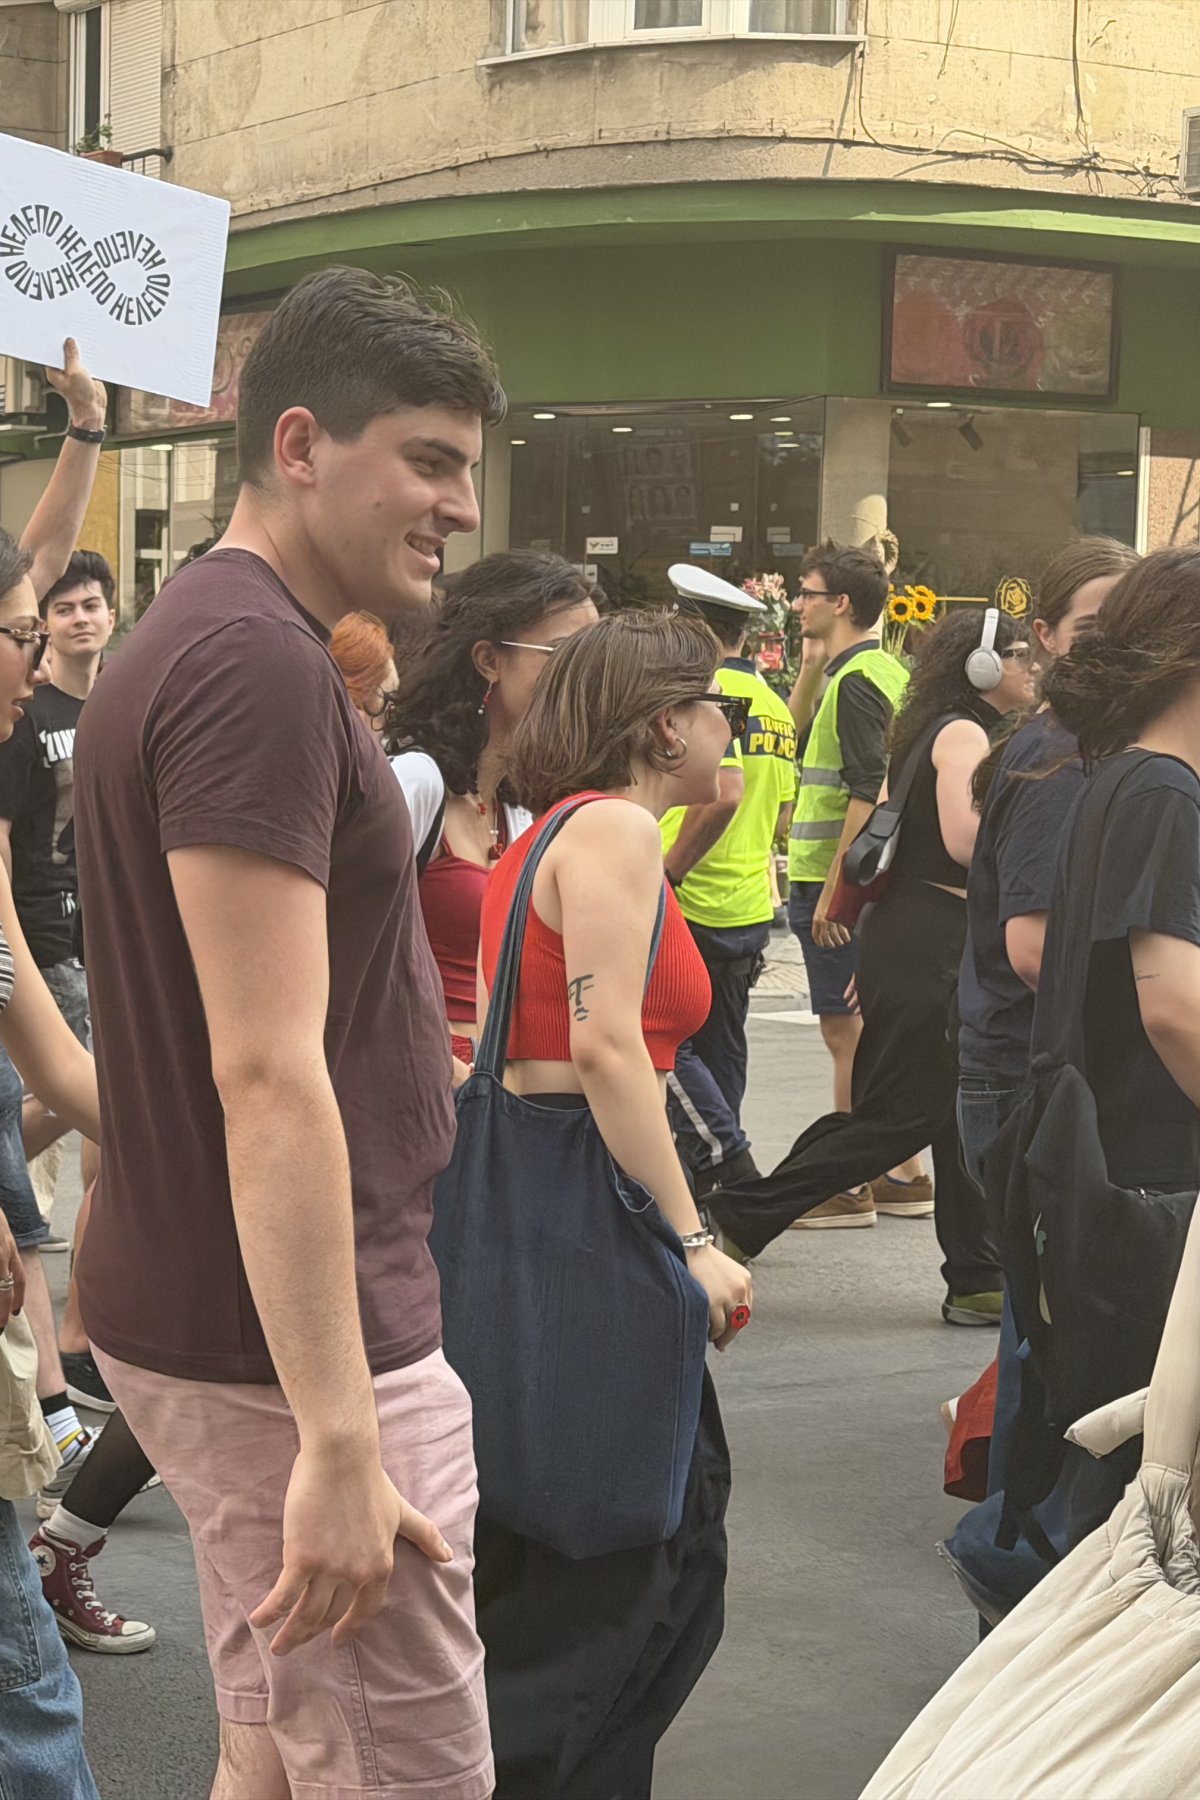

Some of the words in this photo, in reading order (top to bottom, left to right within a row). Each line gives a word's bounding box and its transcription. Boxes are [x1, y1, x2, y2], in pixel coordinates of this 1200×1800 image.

[0, 204, 64, 258] НЕЛЕПО
[93, 230, 167, 272] НЕЛЕПО
[4, 260, 81, 301] НЕЛЕПО
[55, 224, 117, 306] НЕЛЕПО
[108, 273, 171, 326] НЕЛЕПО
[749, 732, 796, 759] POIC
